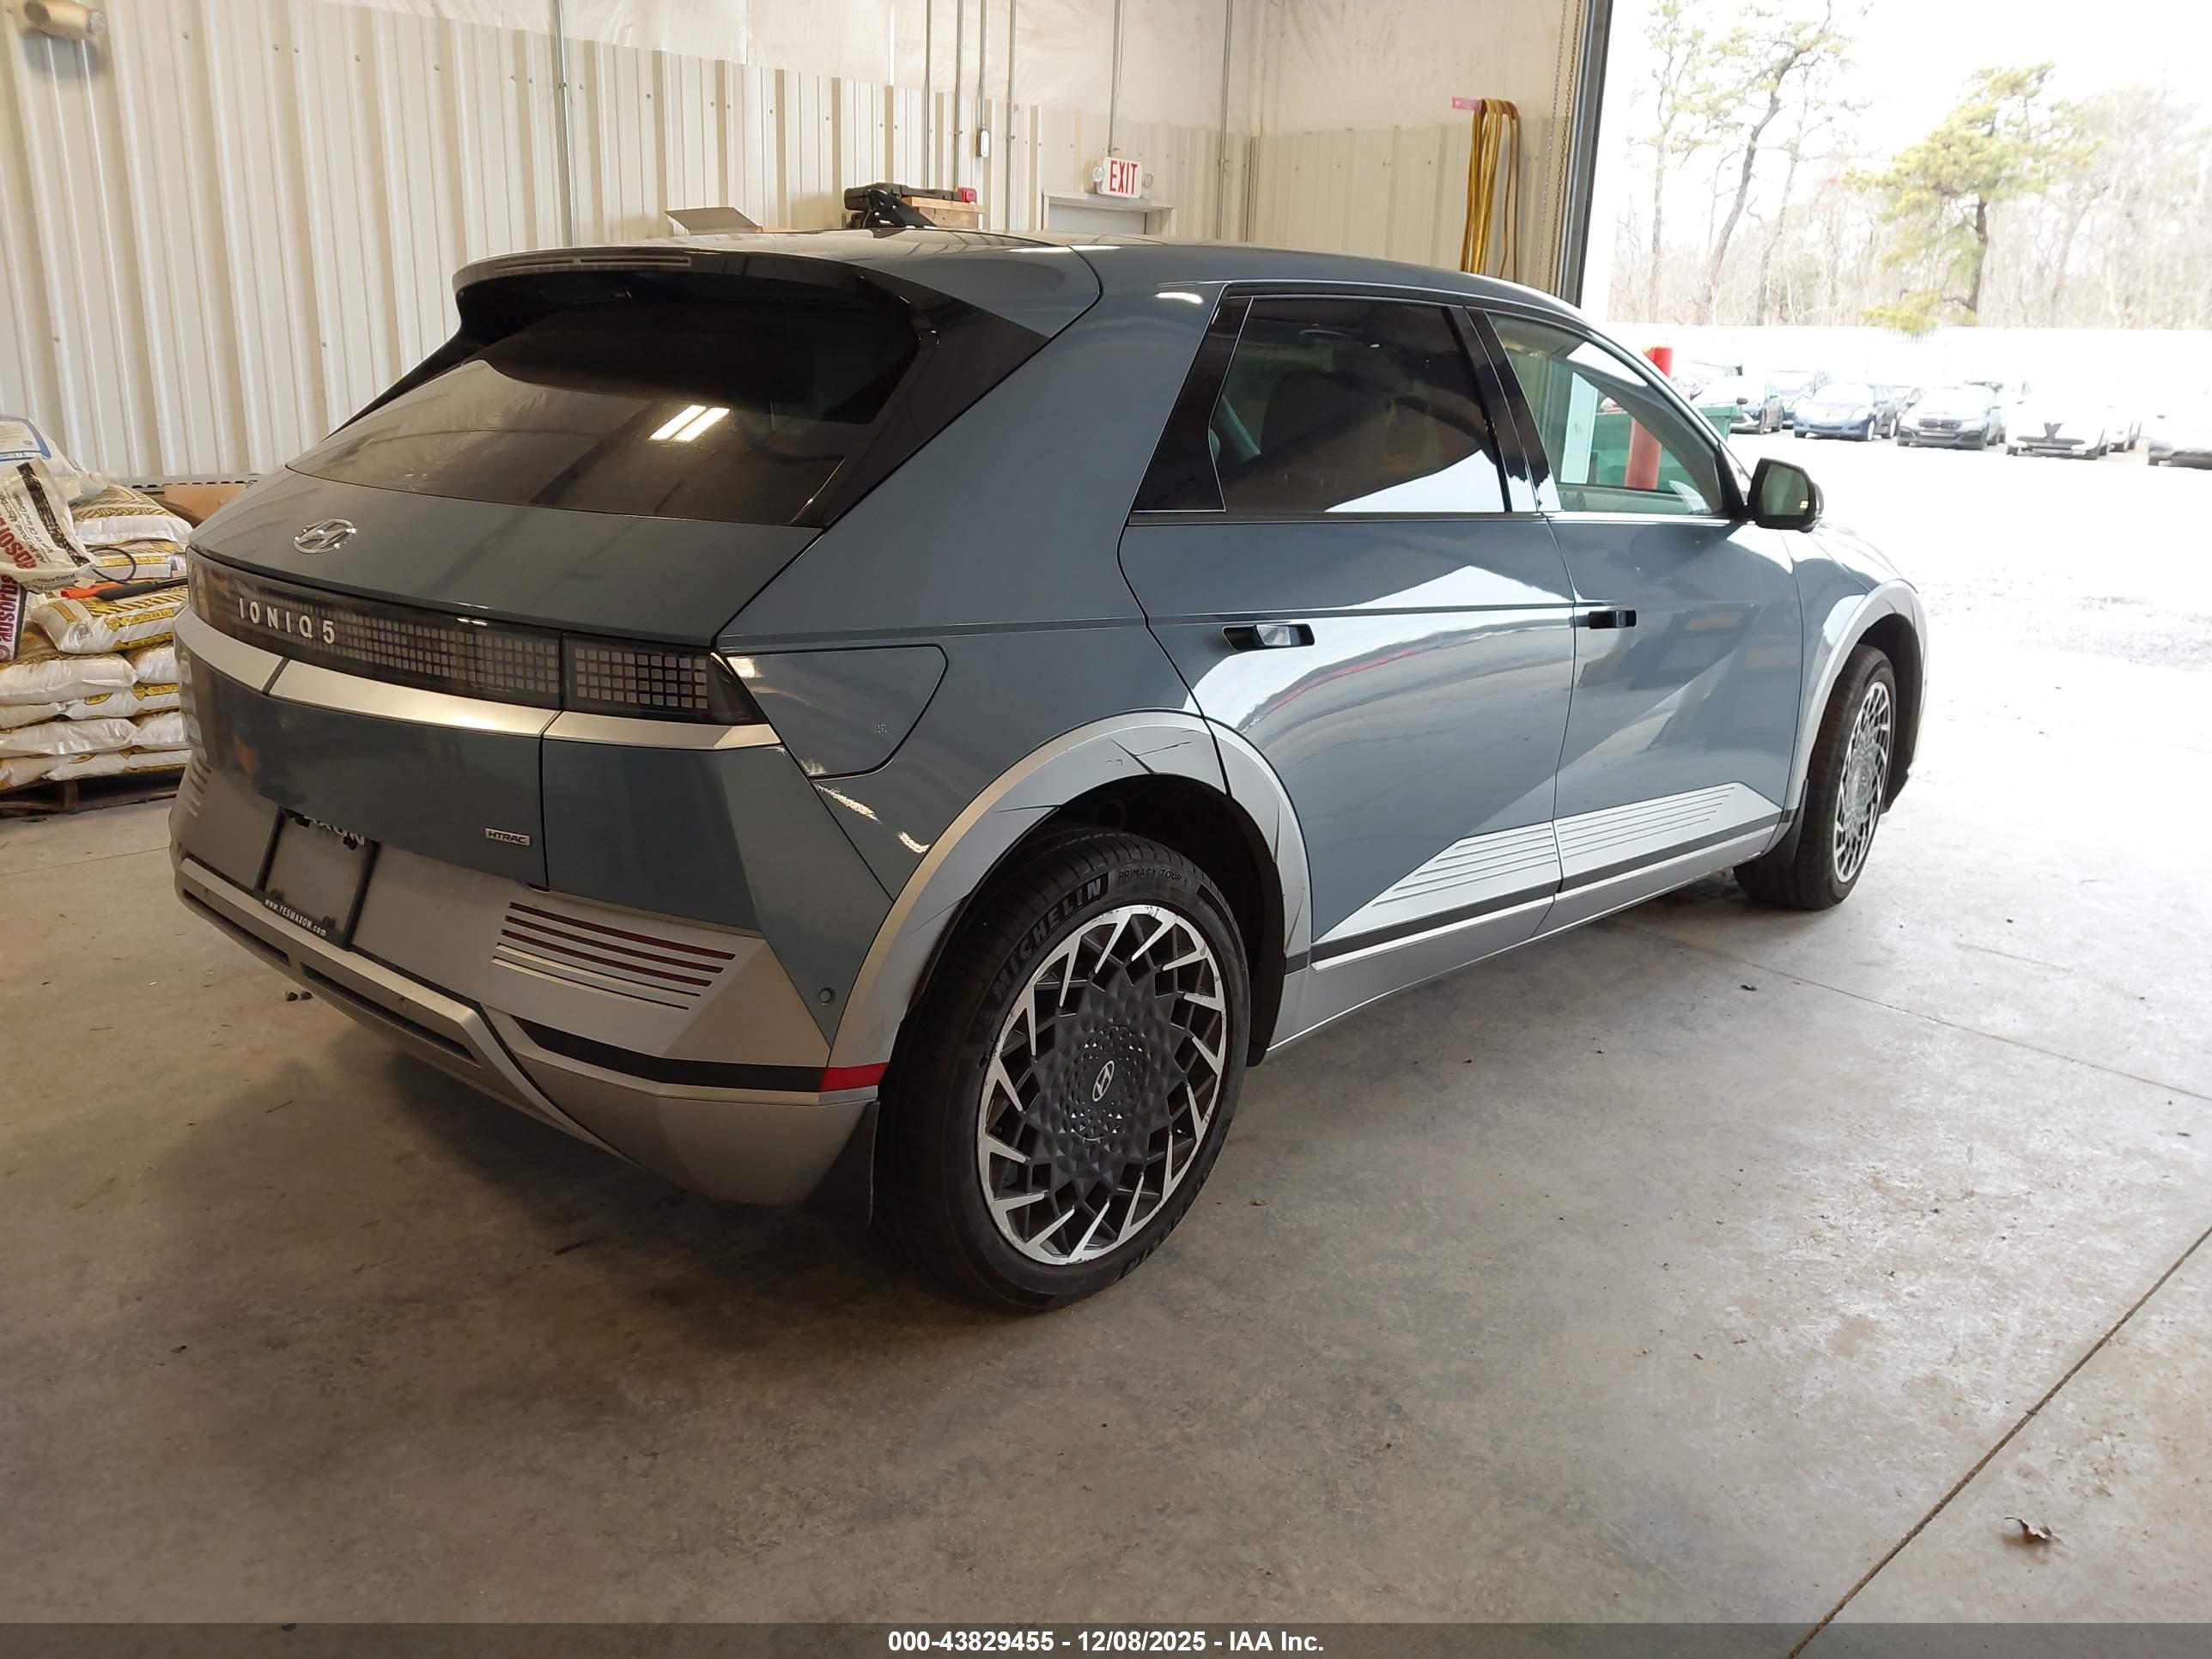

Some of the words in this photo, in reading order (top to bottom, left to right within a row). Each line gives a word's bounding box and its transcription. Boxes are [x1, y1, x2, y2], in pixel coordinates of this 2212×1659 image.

[1109, 160, 1138, 194] EXIT
[240, 598, 313, 639] IONIQ
[323, 620, 335, 644] 5
[489, 830, 527, 844] HTRAC
[1118, 867, 1158, 880] PRIMACY
[1160, 869, 1182, 881] TOUR
[264, 898, 326, 937] www.YESMAXON.com
[992, 878, 1101, 1001] MICHELIN
